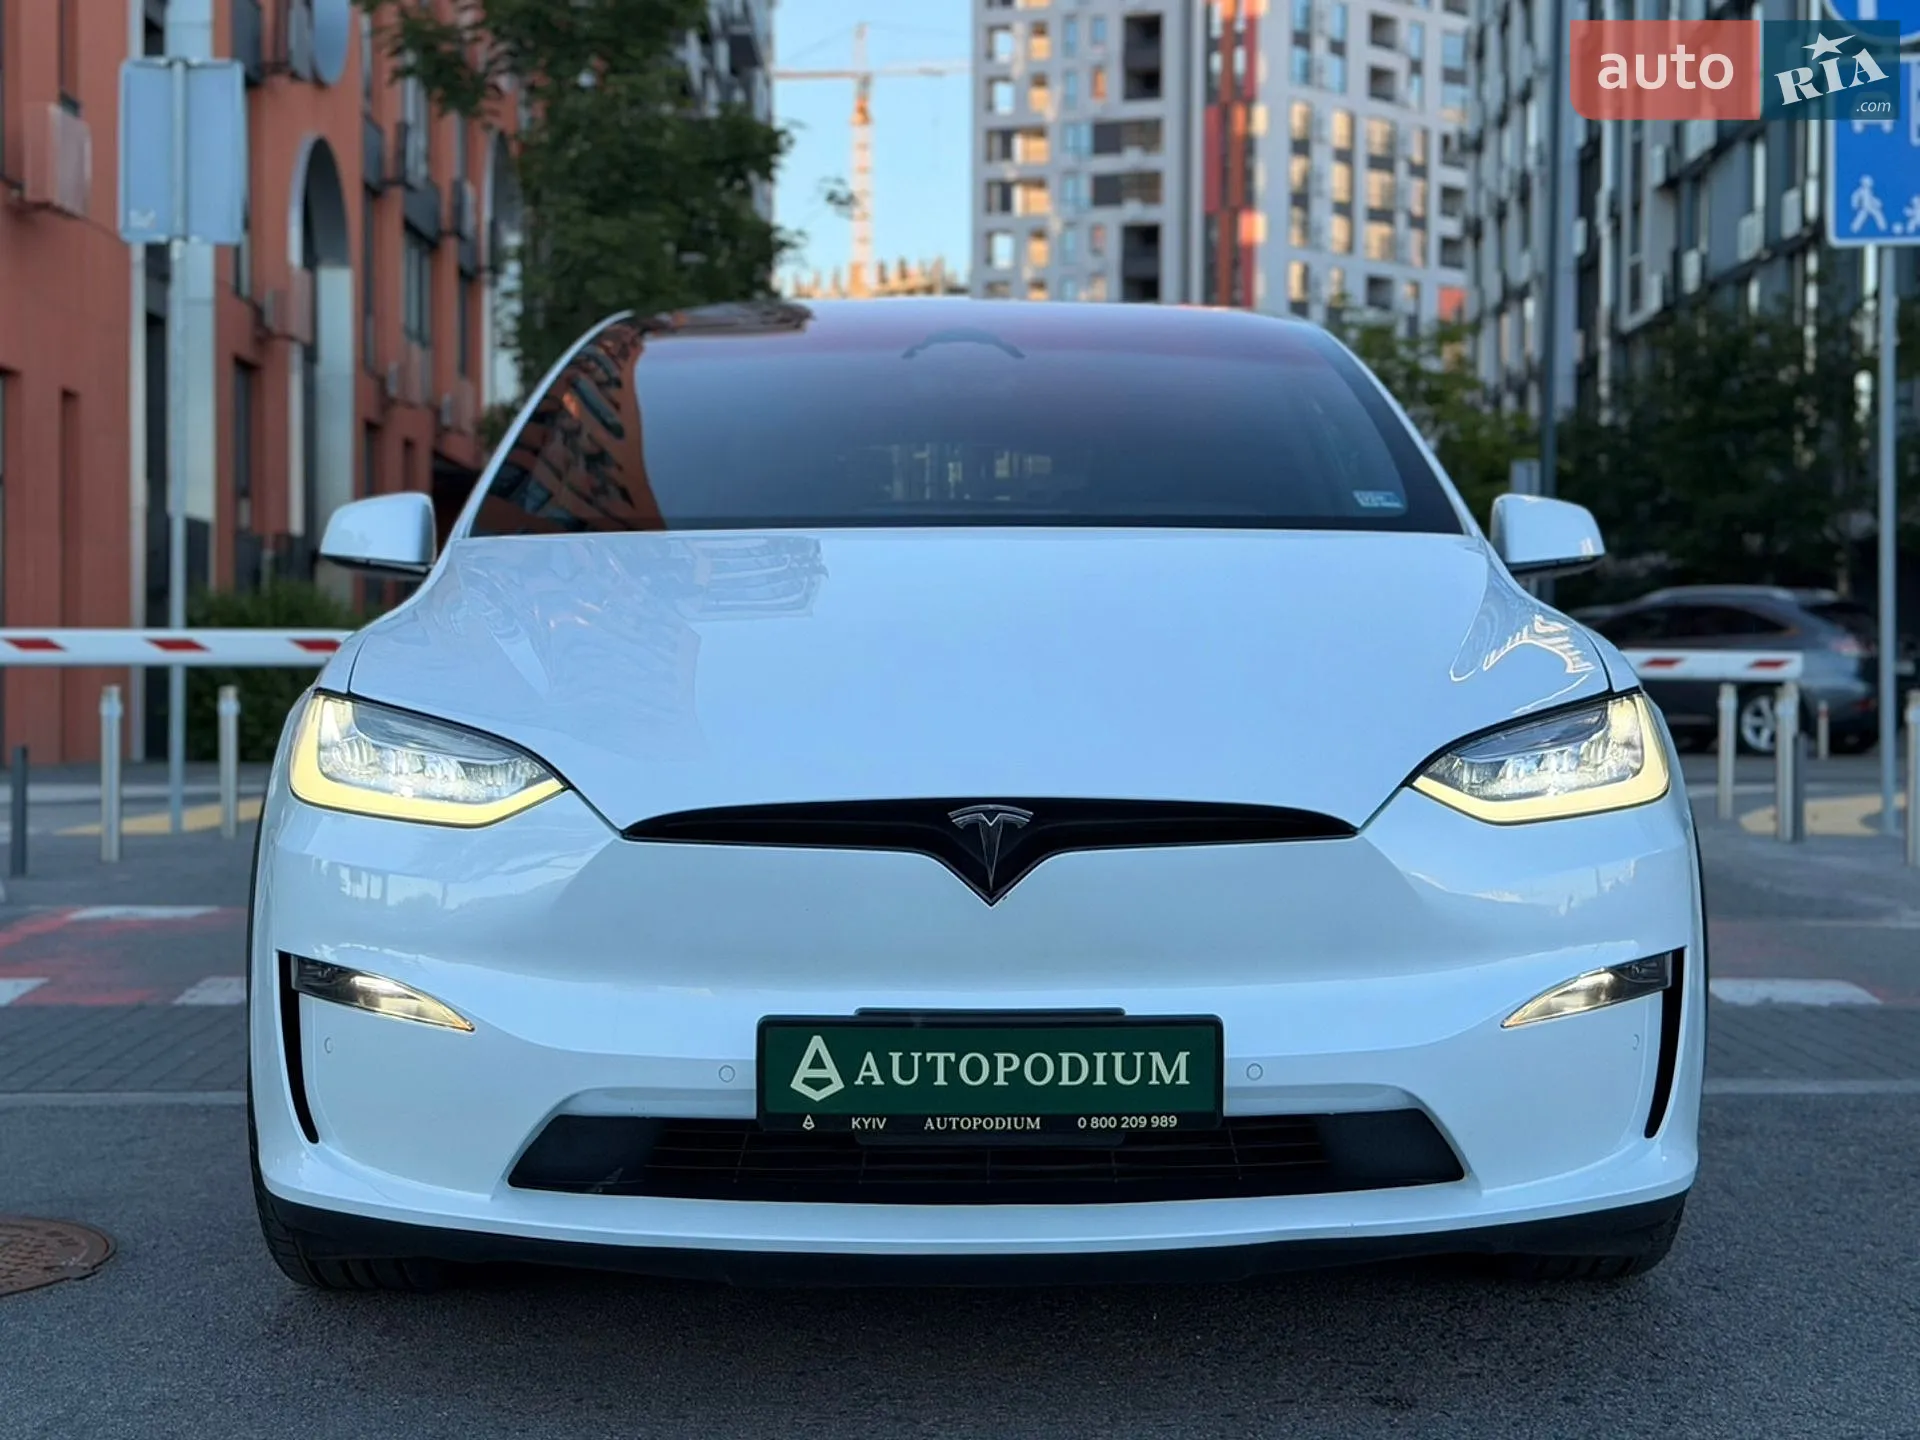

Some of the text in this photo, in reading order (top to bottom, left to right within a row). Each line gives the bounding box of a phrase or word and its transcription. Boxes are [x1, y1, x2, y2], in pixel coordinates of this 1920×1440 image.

[853, 1051, 1191, 1086] AUTOPODIUM
[851, 1115, 1178, 1130] KYIV AUTOPODIUM 0 800 209 989
